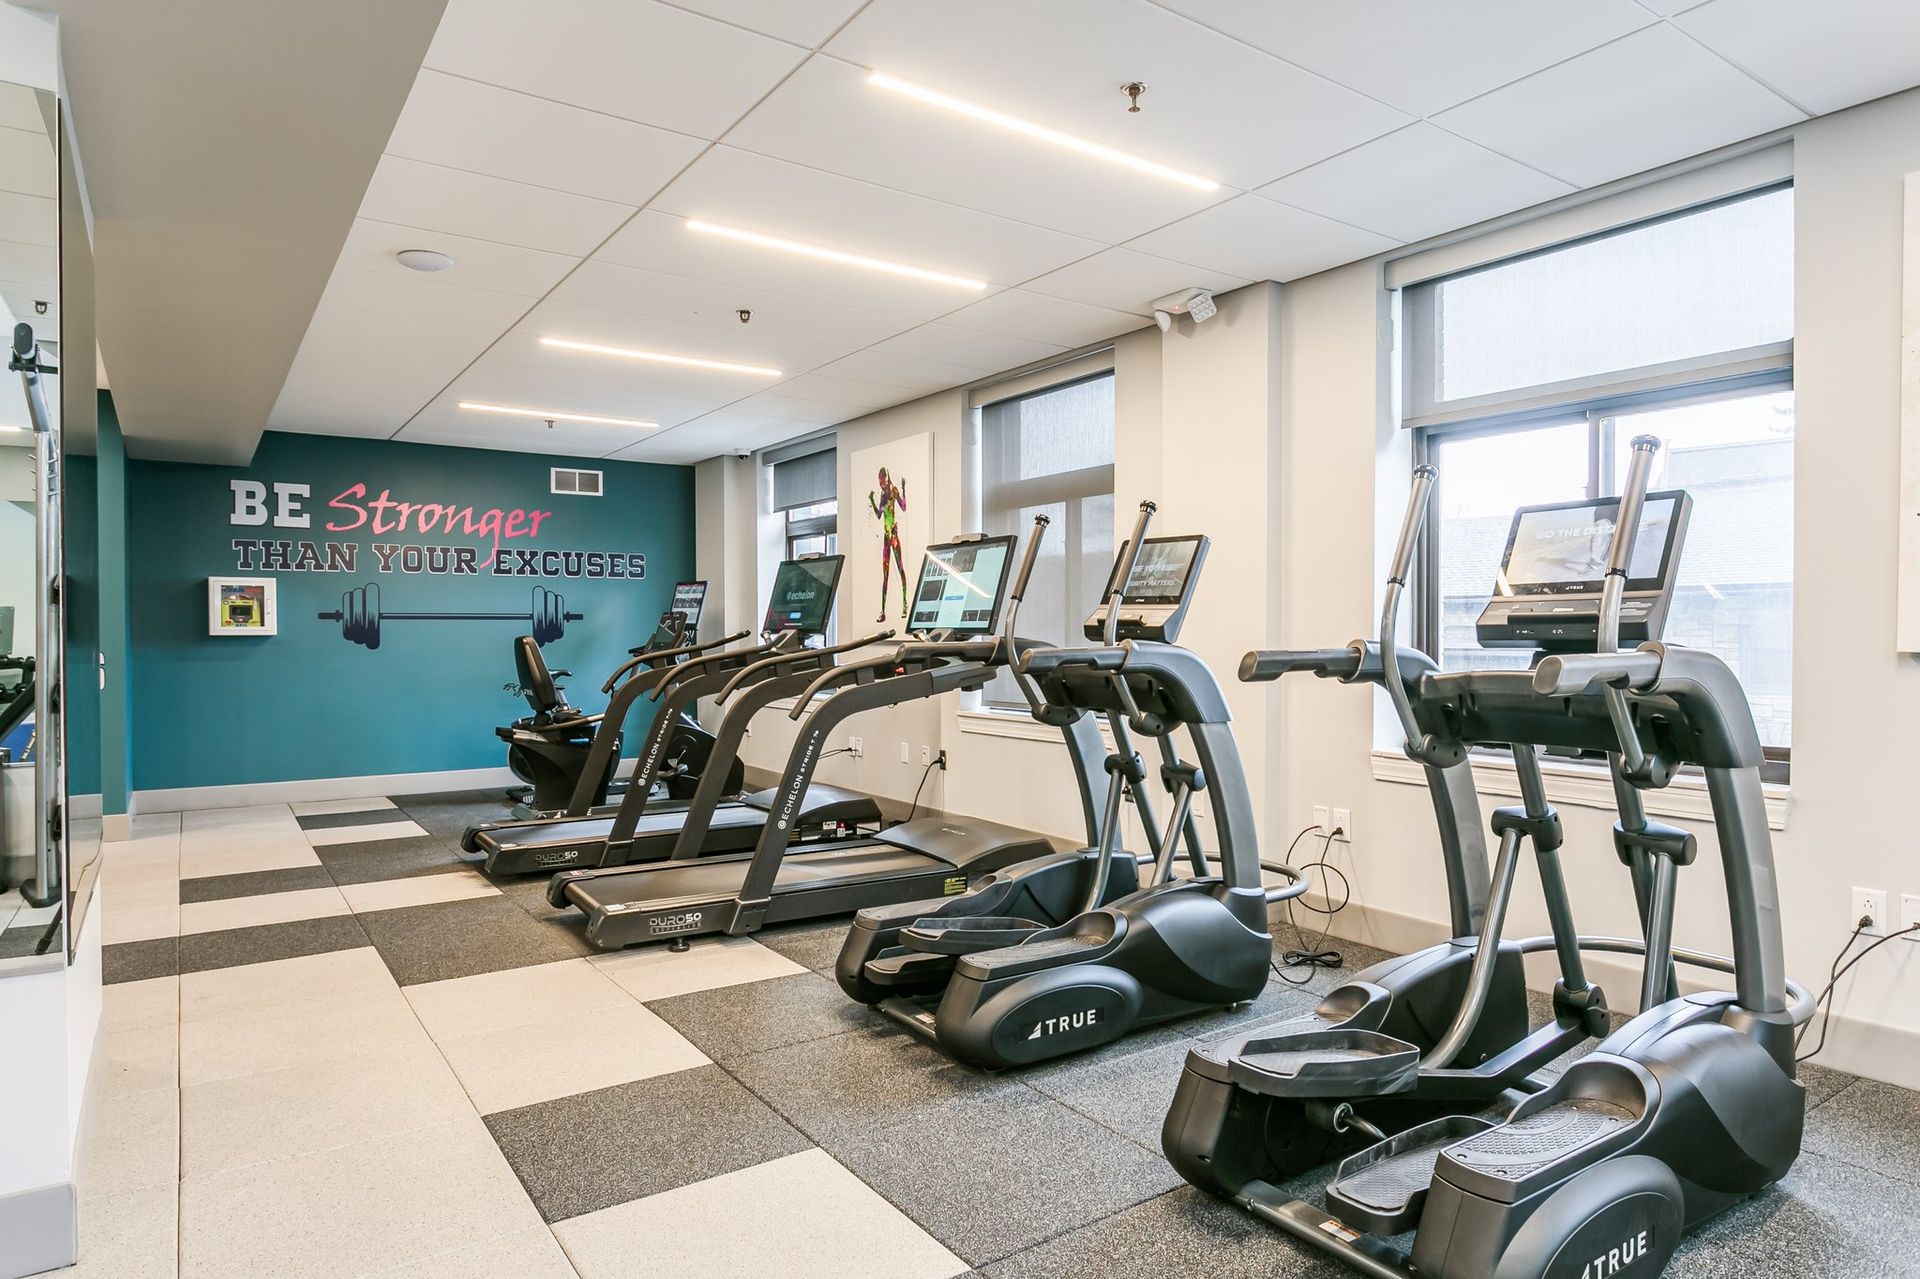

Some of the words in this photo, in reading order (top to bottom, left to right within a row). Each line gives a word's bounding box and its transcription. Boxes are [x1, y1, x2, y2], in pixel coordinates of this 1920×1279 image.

[230, 479, 311, 528] BE
[326, 483, 553, 569] Stronger
[232, 539, 358, 573] THAN
[372, 543, 478, 576] YOUR
[492, 546, 647, 580] EXCUSES
[791, 591, 815, 600] echelon
[641, 743, 660, 779] ECHELON
[781, 774, 804, 820] ECHELON
[650, 912, 702, 927] DURO50
[1045, 1009, 1097, 1035] TRUE
[1593, 1230, 1648, 1279] TRUE
